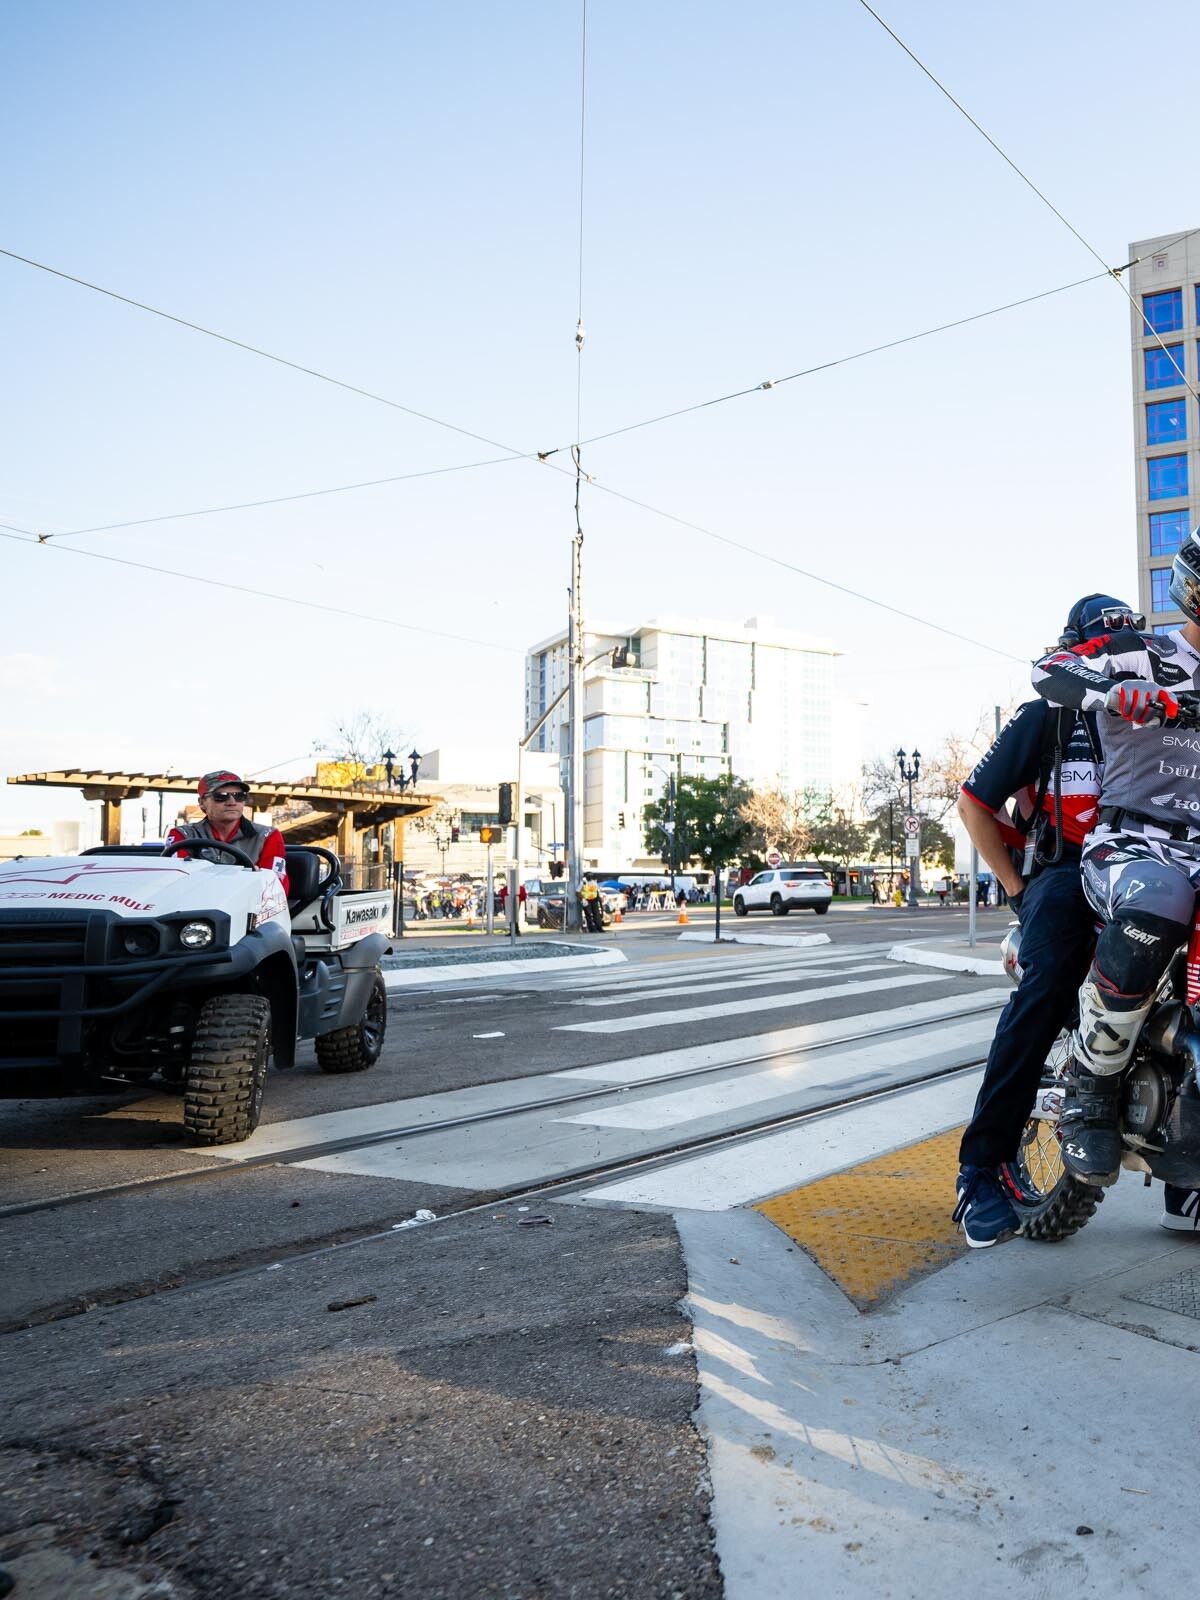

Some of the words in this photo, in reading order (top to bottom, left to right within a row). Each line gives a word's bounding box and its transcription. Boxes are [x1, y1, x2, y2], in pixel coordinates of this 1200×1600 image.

[47, 892, 106, 901] MEDIC
[108, 895, 156, 911] MULE
[345, 908, 379, 925] Kawasaki
